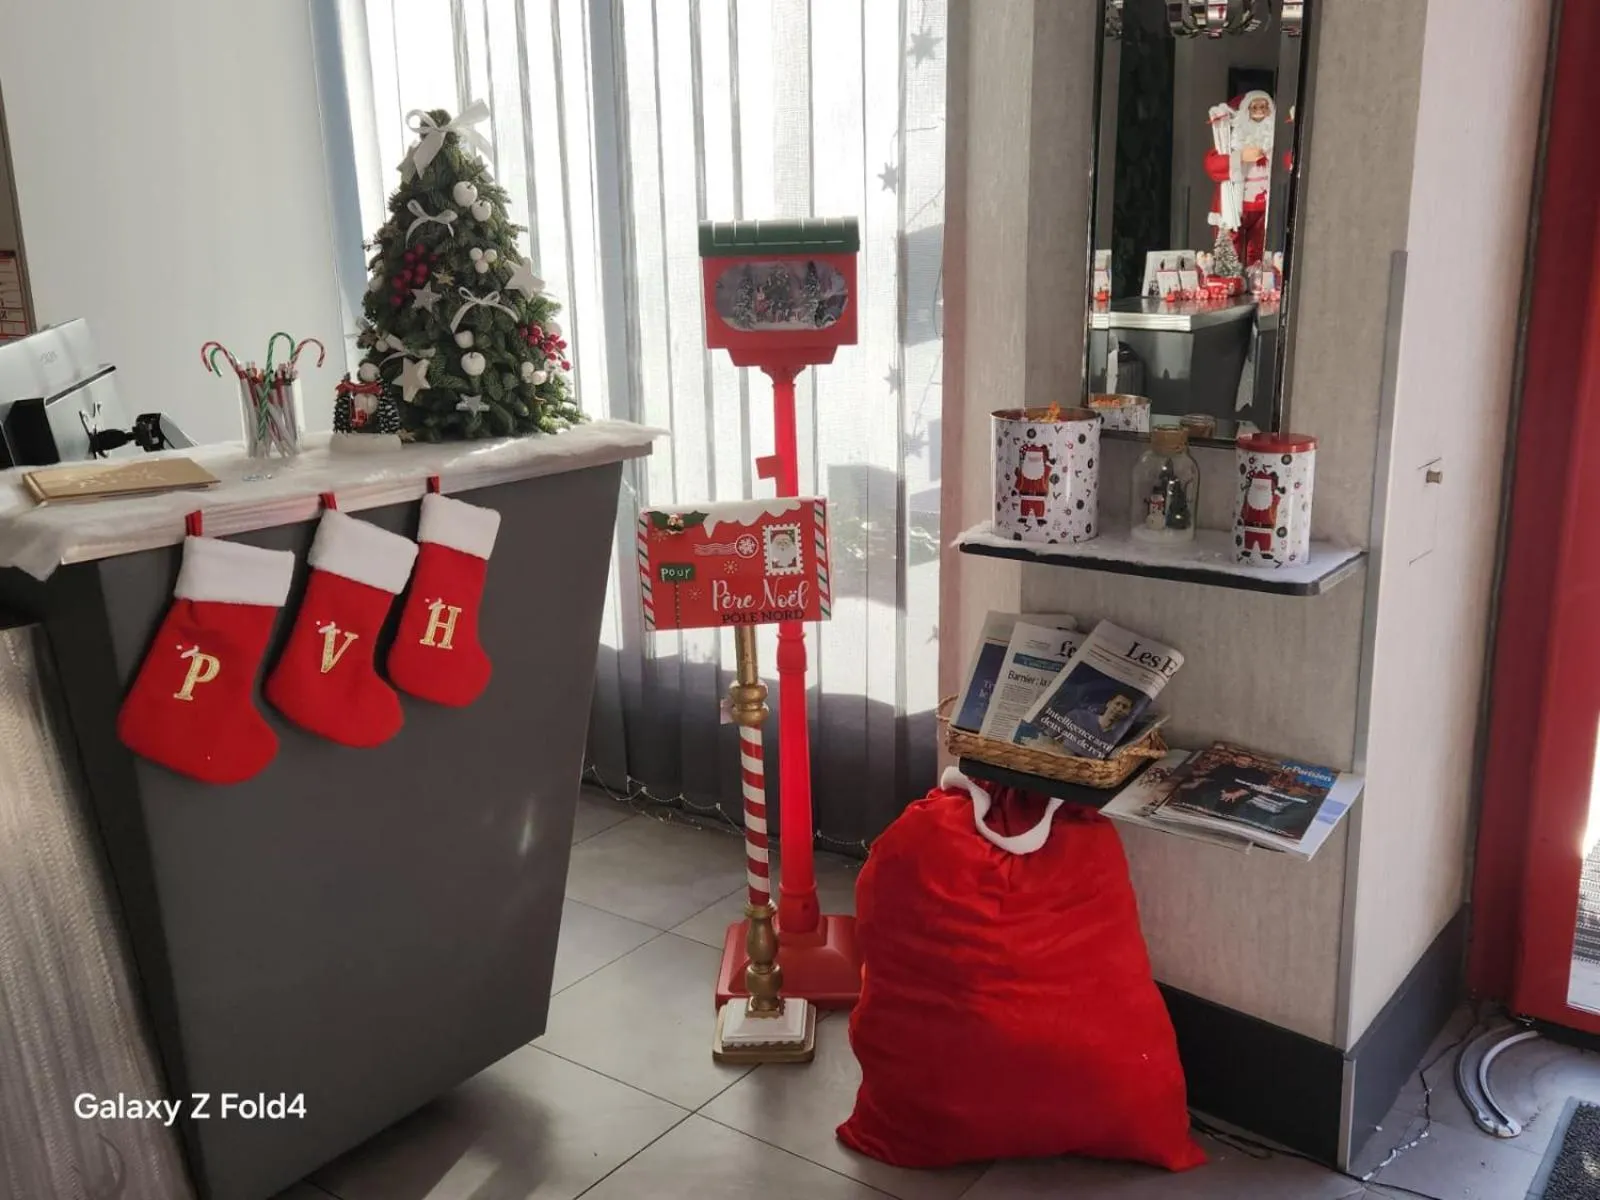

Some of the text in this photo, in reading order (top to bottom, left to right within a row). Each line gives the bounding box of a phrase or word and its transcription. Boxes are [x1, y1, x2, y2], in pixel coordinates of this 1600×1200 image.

[712, 577, 810, 612] Père Noël
[419, 602, 462, 650] H
[761, 610, 805, 623] NORD
[318, 626, 359, 674] V
[1124, 641, 1161, 668] Les
[173, 650, 221, 701] P
[1040, 716, 1063, 733] deux
[1061, 730, 1077, 743] ans
[1045, 707, 1095, 741] Intelligence
